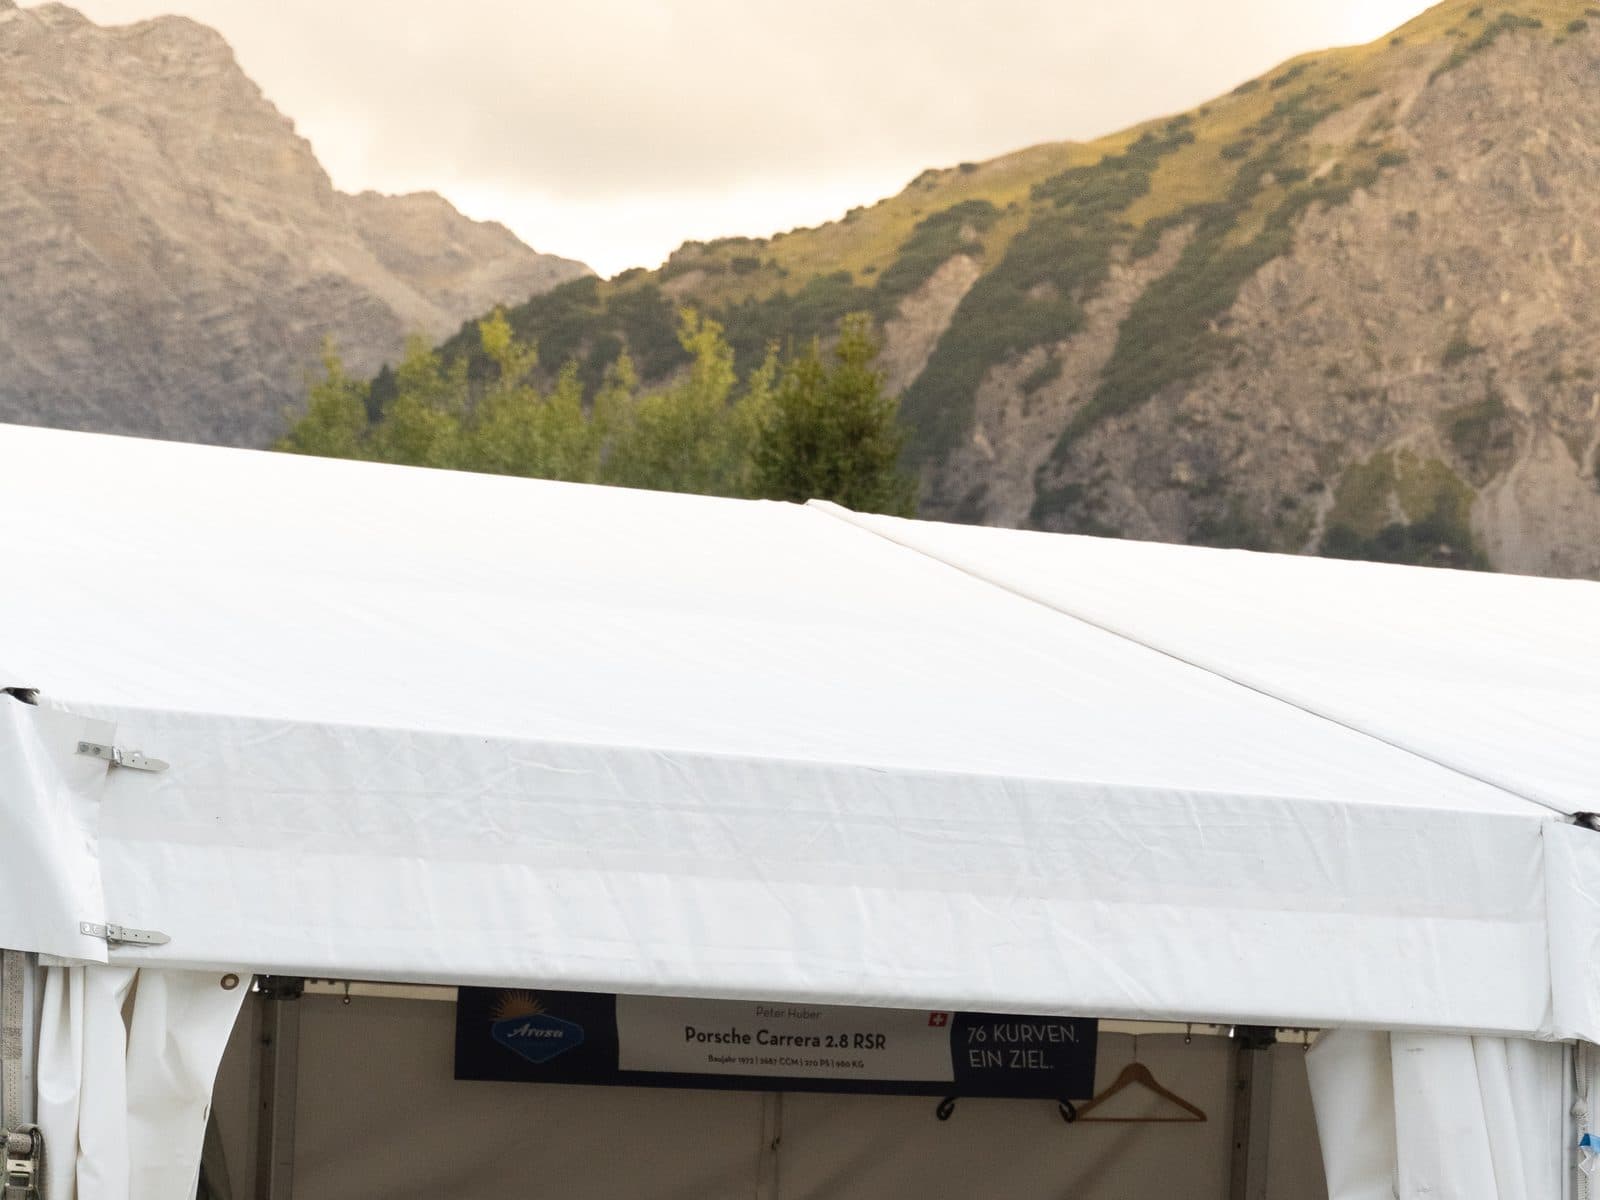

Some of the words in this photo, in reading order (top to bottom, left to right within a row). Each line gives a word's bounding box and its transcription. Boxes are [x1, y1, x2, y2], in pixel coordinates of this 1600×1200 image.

[756, 1006, 785, 1018] Peter
[788, 1007, 822, 1019] Huber
[506, 1023, 564, 1038] Arosa
[684, 1026, 752, 1044] Porsche
[756, 1029, 821, 1047] Carrera
[825, 1033, 849, 1048] 2.8
[853, 1033, 886, 1050] RSR
[967, 1025, 987, 1043] 76
[993, 1024, 1080, 1043] KURVEN.
[969, 1050, 1002, 1068] EIN
[1009, 1050, 1055, 1069] ZIEL.
